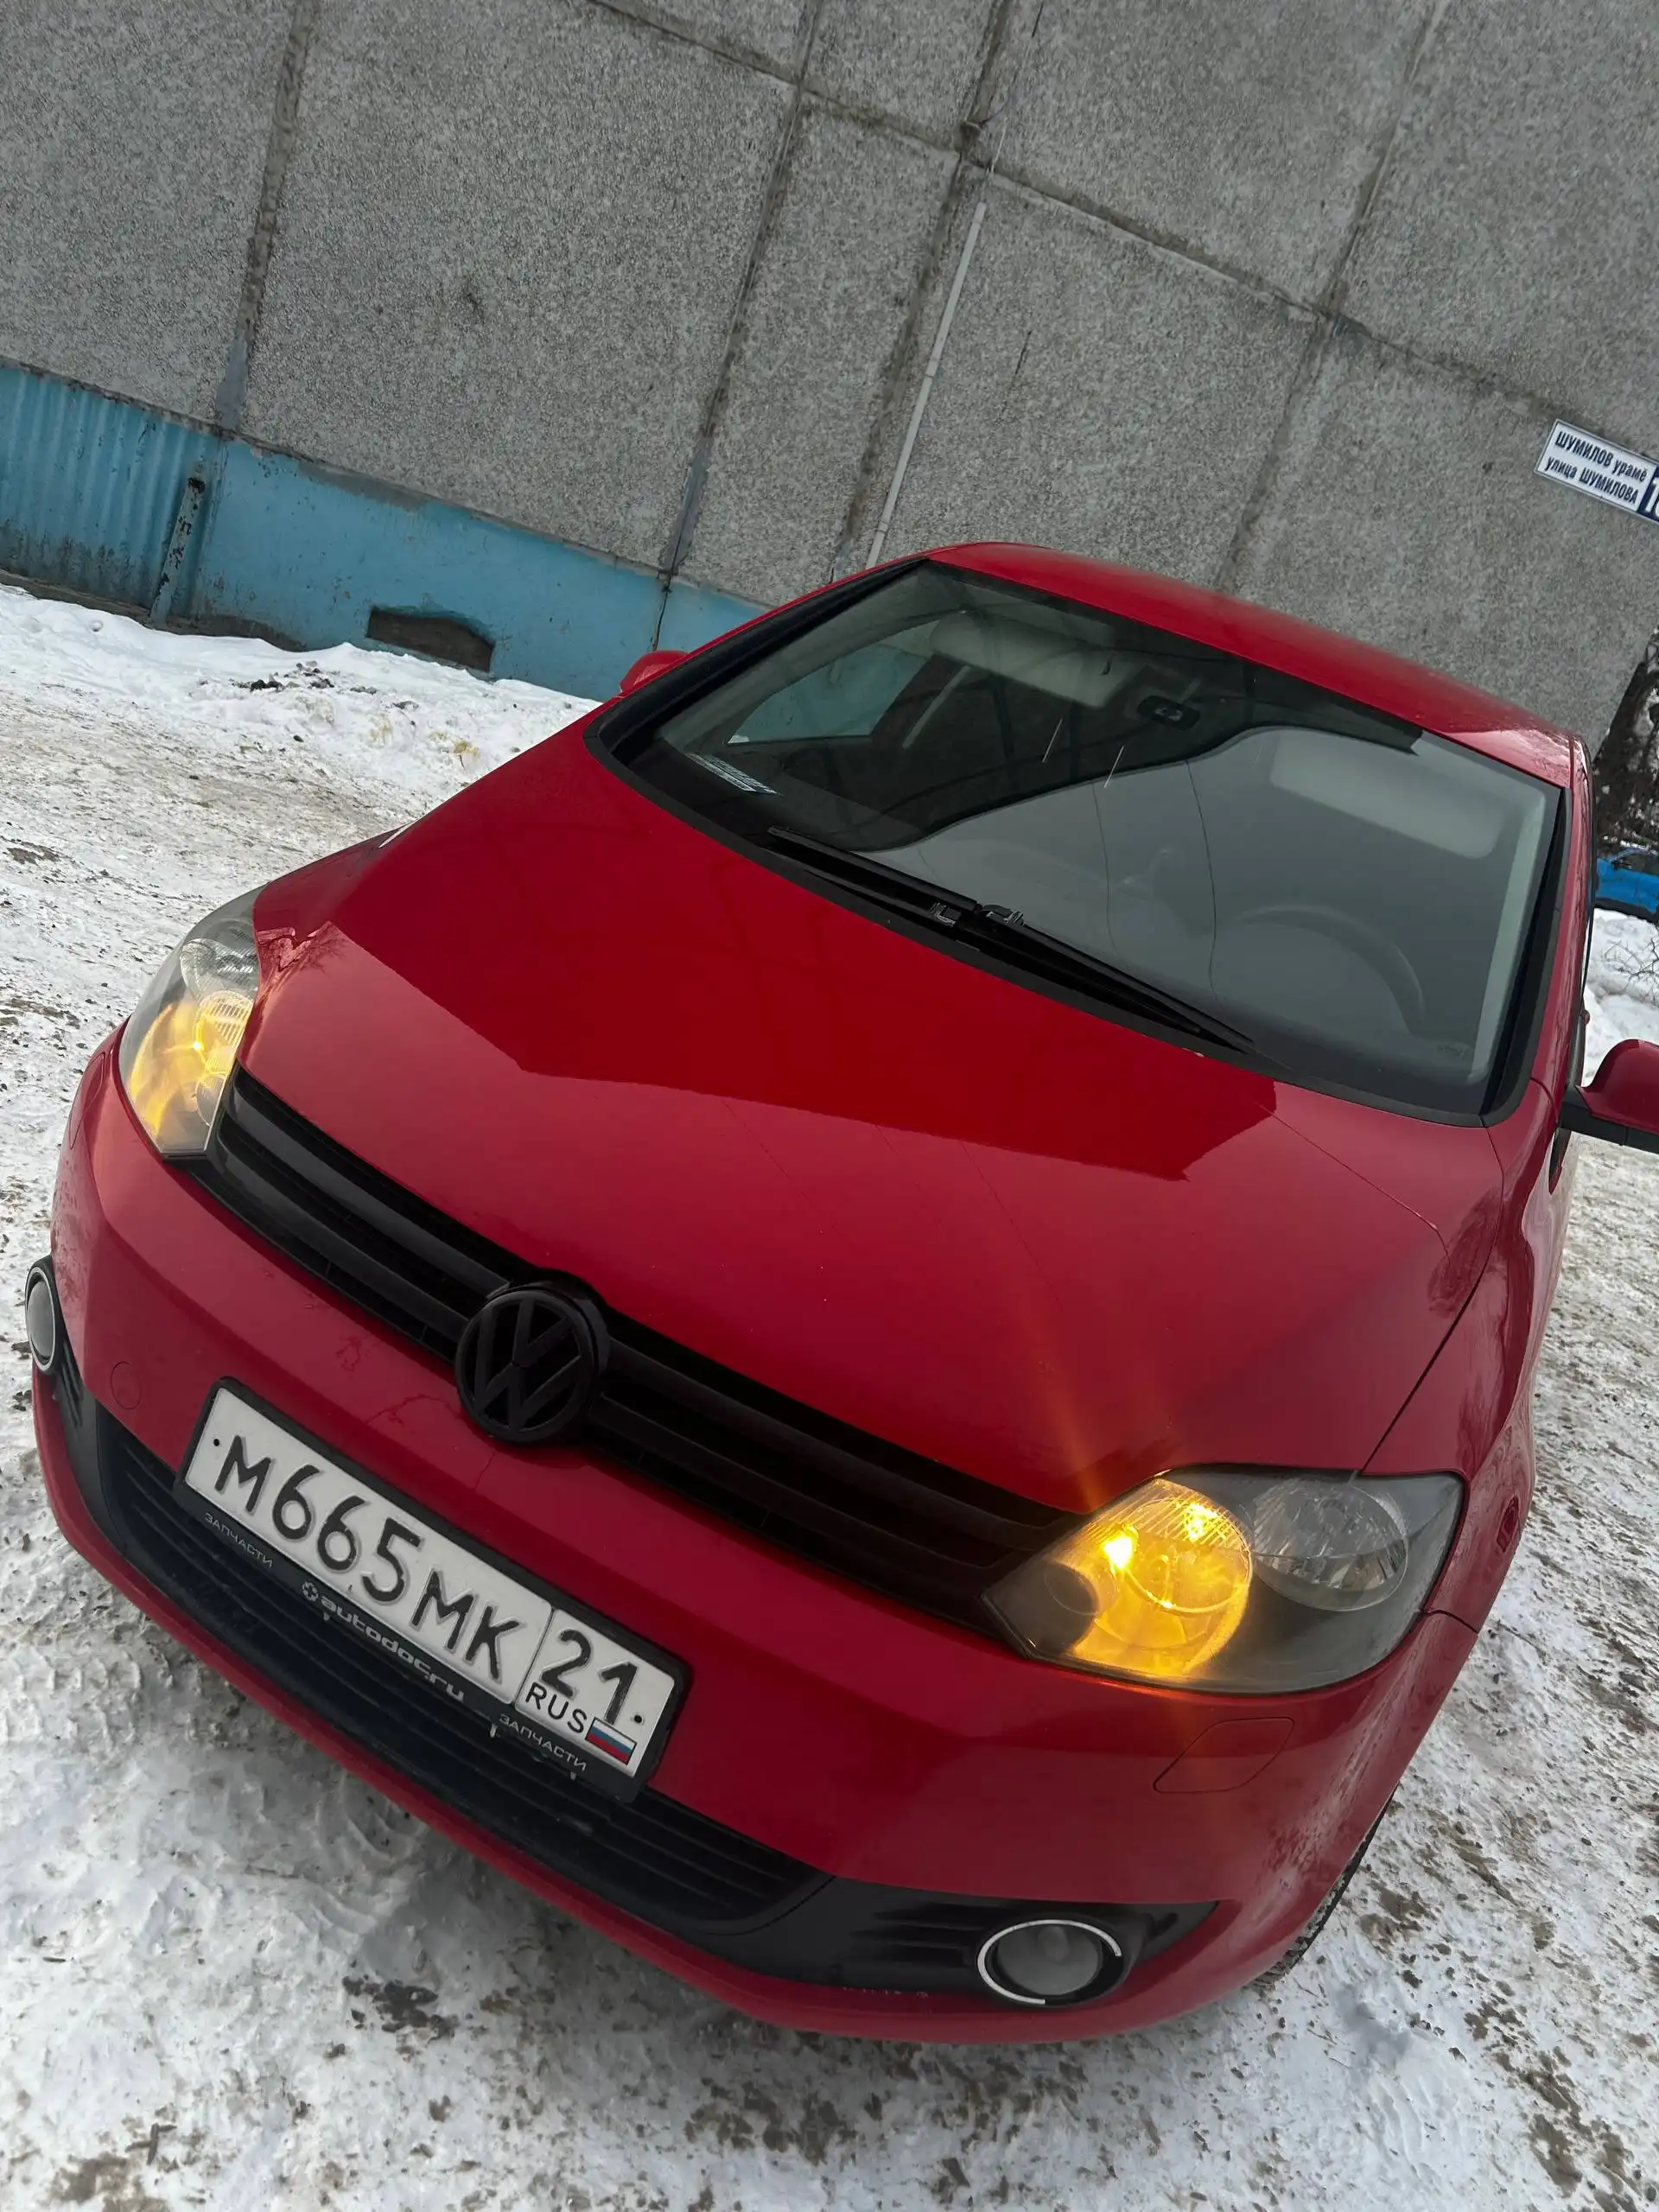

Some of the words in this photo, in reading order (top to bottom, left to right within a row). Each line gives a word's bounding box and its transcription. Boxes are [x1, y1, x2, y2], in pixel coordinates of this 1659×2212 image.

[1554, 430, 1614, 467] ШУМИЛОВ
[1544, 456, 1578, 479] улица
[1579, 467, 1639, 505] ШУМИЛОВА
[205, 1511, 273, 1568] ЗАПЧАСТИ
[321, 1595, 464, 1701] autodoc.ru
[499, 1713, 587, 1771] ЗАПЧАСТИ
[539, 1629, 639, 1726] 21
[525, 1681, 588, 1734] RUS
